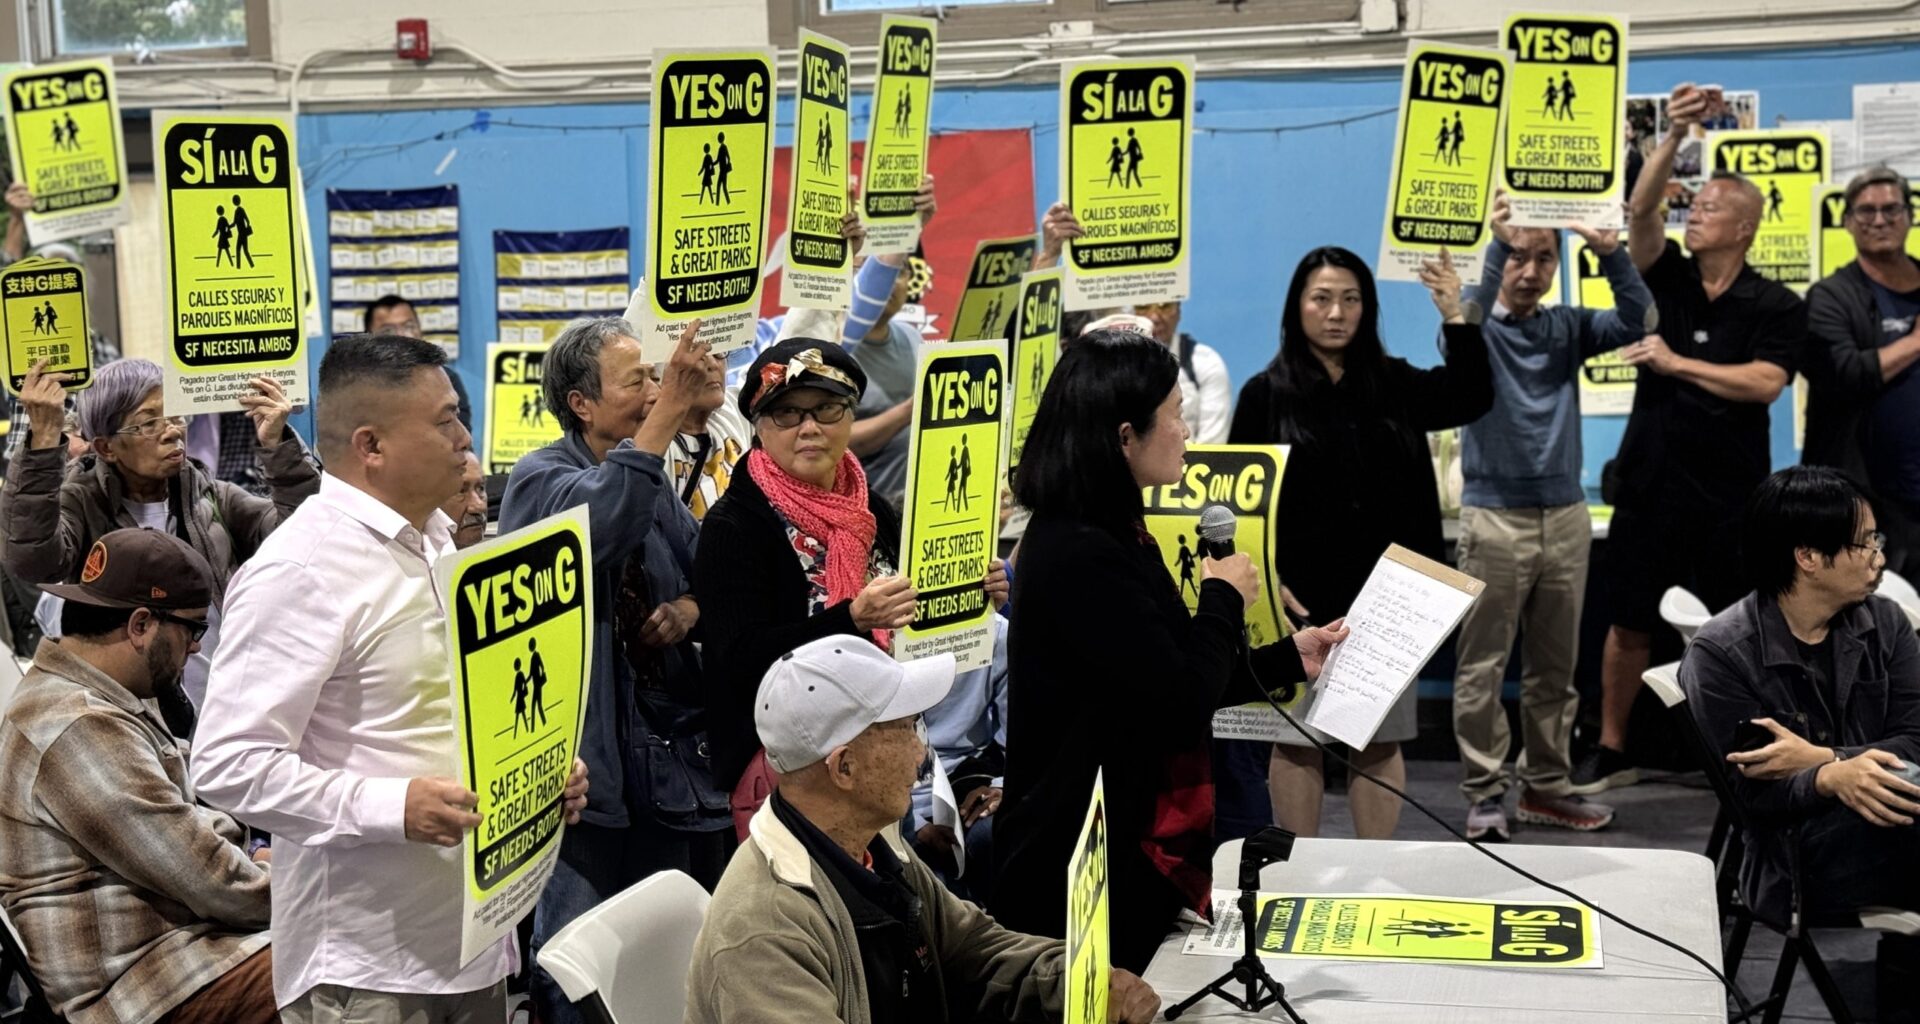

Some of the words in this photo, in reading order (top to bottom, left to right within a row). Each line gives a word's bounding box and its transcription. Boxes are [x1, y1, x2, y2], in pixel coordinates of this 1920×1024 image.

[887, 35, 913, 71] YES
[920, 37, 930, 73] G
[1513, 26, 1572, 62] YES
[1571, 36, 1591, 57] ON
[1591, 28, 1613, 63] G
[804, 53, 830, 99] YES
[837, 65, 846, 104] G
[1418, 60, 1466, 100] YES
[1465, 74, 1480, 96] ON
[1480, 67, 1500, 104] G
[13, 77, 68, 110] YES
[83, 72, 104, 101] G
[669, 73, 726, 119] YES
[727, 84, 743, 110] ON
[745, 72, 763, 117] G
[1081, 72, 1118, 121] SÍ
[1116, 90, 1127, 113] A
[1128, 89, 1145, 112] LA
[1148, 75, 1173, 118] G
[1518, 133, 1547, 150] SAFE
[1550, 135, 1600, 151] STREETS
[179, 127, 216, 184] SÍ
[218, 149, 230, 176] A
[230, 149, 249, 176] LA
[251, 134, 277, 184] G
[876, 154, 894, 170] SAFE
[894, 153, 919, 170] STREETS
[1515, 151, 1523, 165] &
[1525, 151, 1561, 167] GREAT
[1564, 152, 1602, 167] PARKS
[1720, 143, 1777, 173] YES
[1795, 141, 1818, 172] G
[36, 164, 60, 180] SAFE
[63, 158, 106, 175] STREETS
[872, 173, 878, 189] &
[879, 172, 899, 189] GREAT
[900, 172, 918, 189] PARKS
[1512, 171, 1527, 187] SF
[1528, 172, 1566, 189] NEEDS
[1567, 173, 1604, 189] BOTH!
[43, 175, 77, 192] GREAT
[78, 172, 110, 188] PARKS
[1410, 179, 1436, 197] SAFE
[1438, 181, 1479, 200] STREETS
[34, 198, 48, 212] SF
[49, 191, 83, 209] NEEDS
[802, 190, 817, 210] SAFE
[817, 192, 842, 214] STREETS
[1082, 206, 1116, 222] CALLES
[1118, 203, 1161, 220] SEGURAS
[1163, 203, 1170, 216] Y
[1404, 199, 1413, 214] &
[1414, 199, 1447, 217] GREAT
[1448, 201, 1478, 219] PARKS
[798, 211, 804, 230] &
[804, 212, 823, 233] GREAT
[823, 215, 841, 235] PARKS
[1081, 223, 1118, 239] ARQUES
[1119, 218, 1176, 236] MAGNÍFICOS
[1399, 220, 1414, 237] SF
[1414, 222, 1449, 240] NEEDS
[1450, 225, 1477, 242] BOTH!
[674, 227, 705, 250] SAFE
[707, 222, 751, 247] STREETS
[1760, 234, 1809, 248] STREETS
[670, 253, 680, 275] &
[682, 250, 719, 274] GREAT
[721, 246, 752, 270] PARKS
[795, 239, 804, 257] SF
[804, 240, 824, 259] NEEDS
[824, 243, 842, 261] BOTH!
[1078, 249, 1091, 264] SF
[1092, 246, 1138, 262] NECESITA
[1140, 243, 1174, 259] AMBOS
[974, 250, 1012, 285] YES
[5, 272, 79, 295] 支持G提案
[667, 285, 684, 305] SF
[686, 280, 722, 303] NEEDS
[723, 276, 751, 300] BOTH!
[188, 289, 229, 308] CALLES
[231, 287, 277, 306] SEGURAS
[278, 287, 285, 302] Y
[180, 310, 232, 329] PARQUES
[234, 305, 293, 326] MAGNÍFICOS
[1024, 284, 1041, 336] SÍ
[1048, 286, 1057, 330] G
[26, 343, 71, 358] 平日通勤
[184, 342, 200, 358] SF
[202, 339, 256, 357] NECESITA
[258, 336, 292, 353] AMBOS
[27, 354, 71, 369] 週康樂
[501, 352, 528, 384] SÍ
[179, 376, 205, 386] Pagado
[205, 375, 217, 384] por
[217, 373, 236, 383] Great
[1591, 367, 1606, 382] SF
[182, 385, 194, 395] Yes
[205, 384, 213, 393] G.
[214, 384, 227, 392] Las
[930, 370, 970, 421] YES
[970, 380, 983, 410] ON
[984, 368, 998, 416] G
[1208, 473, 1234, 502] ON
[1235, 463, 1265, 512] G
[922, 537, 947, 562] SAFE
[948, 531, 984, 558] STREETS
[917, 566, 925, 589] &
[926, 562, 957, 588] GREAT
[958, 556, 985, 581] PARKS
[464, 563, 535, 641] YES
[534, 566, 554, 606] ON
[555, 545, 577, 605] G
[914, 600, 927, 622] SF
[928, 594, 958, 620] NEEDS
[959, 588, 984, 613] BOTH!
[490, 767, 520, 808] SAFE
[522, 738, 568, 789] STREETS
[486, 813, 496, 842] &
[497, 789, 535, 834] GREAT
[535, 766, 566, 811] PARKS
[483, 848, 501, 881] SF
[500, 825, 536, 869] NEEDS
[1072, 850, 1094, 949] YES
[1310, 900, 1336, 922] PARQUES
[1268, 906, 1294, 931] NECESITA
[1337, 903, 1361, 922] CALLES
[1500, 909, 1577, 929] SÍ
[1262, 930, 1289, 950] AMBOS
[1301, 921, 1330, 952] MAGNÍFICOS
[1333, 921, 1357, 944] SEGURAS
[1511, 932, 1547, 942] LA
[1499, 942, 1569, 956] G
